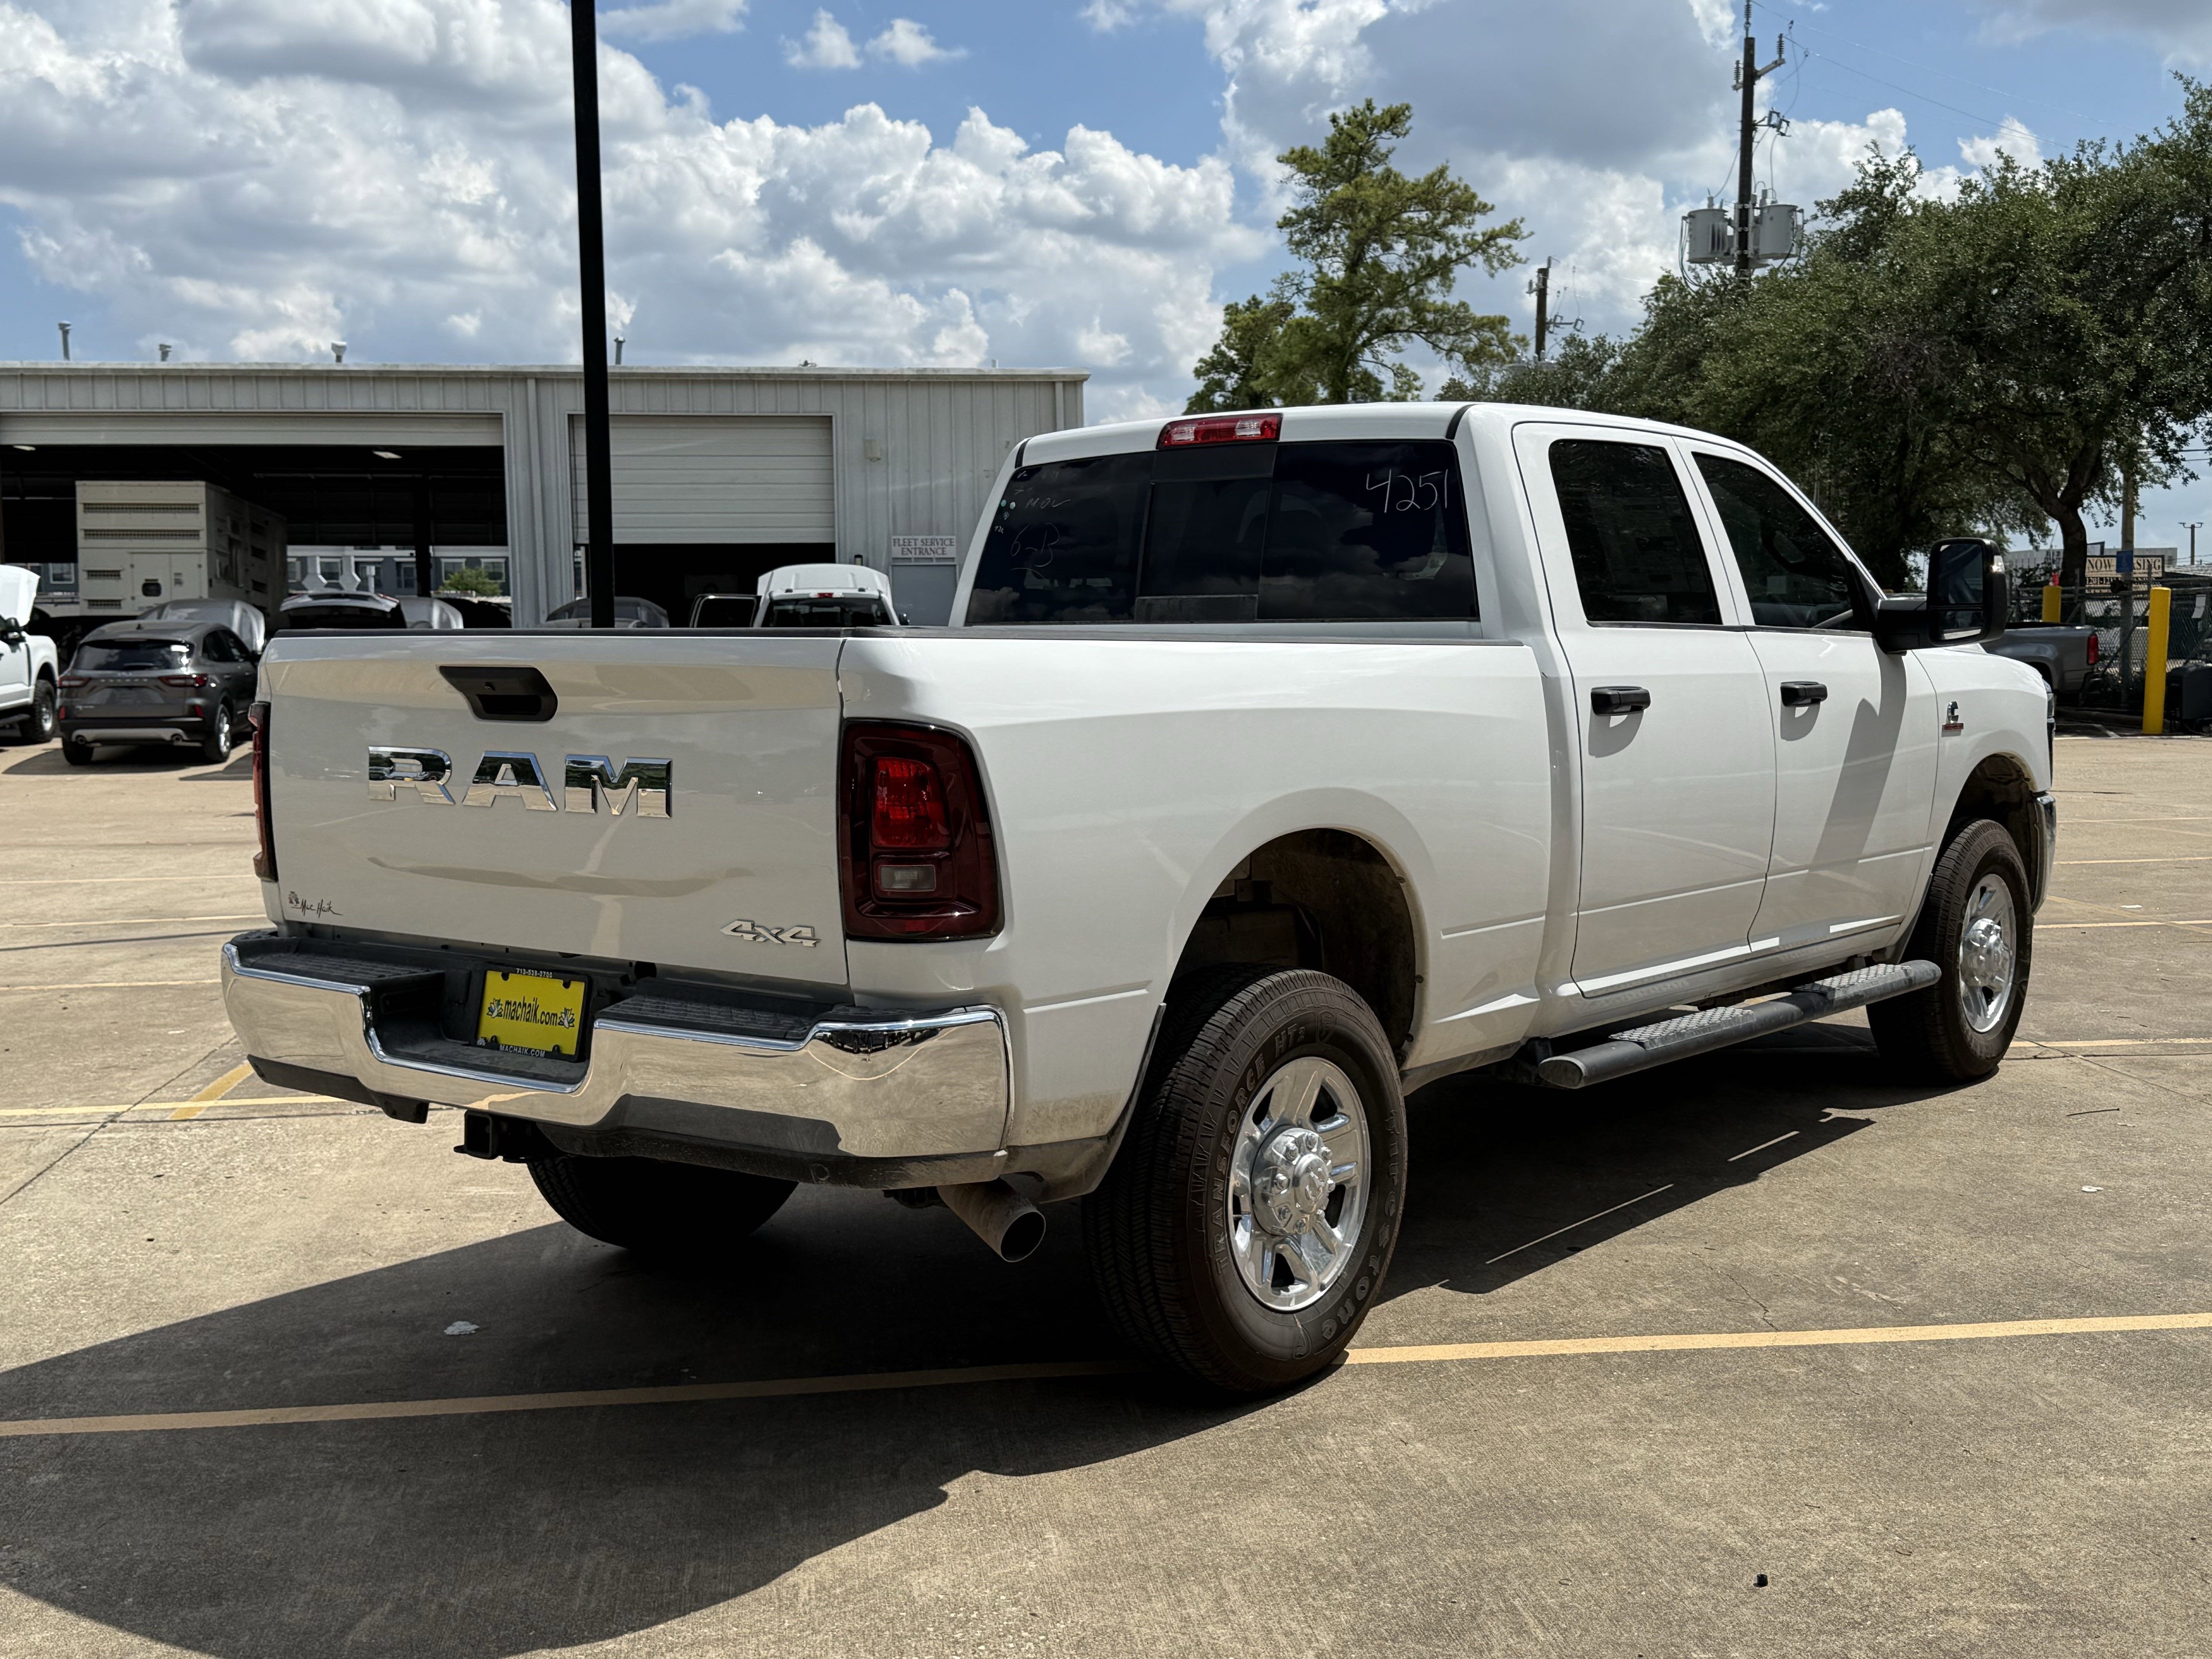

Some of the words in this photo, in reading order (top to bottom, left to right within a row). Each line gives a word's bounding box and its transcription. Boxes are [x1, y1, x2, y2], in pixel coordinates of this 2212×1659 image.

[1366, 469, 1449, 513] 4251
[893, 538, 919, 546] FLEET
[921, 538, 954, 546] SERVICE
[901, 547, 947, 555] ENTRANCE
[2088, 558, 2114, 571] NOW
[369, 746, 672, 818] RAM
[503, 996, 558, 1026] machaik.com
[499, 1044, 545, 1057] MACHAIK.COM
